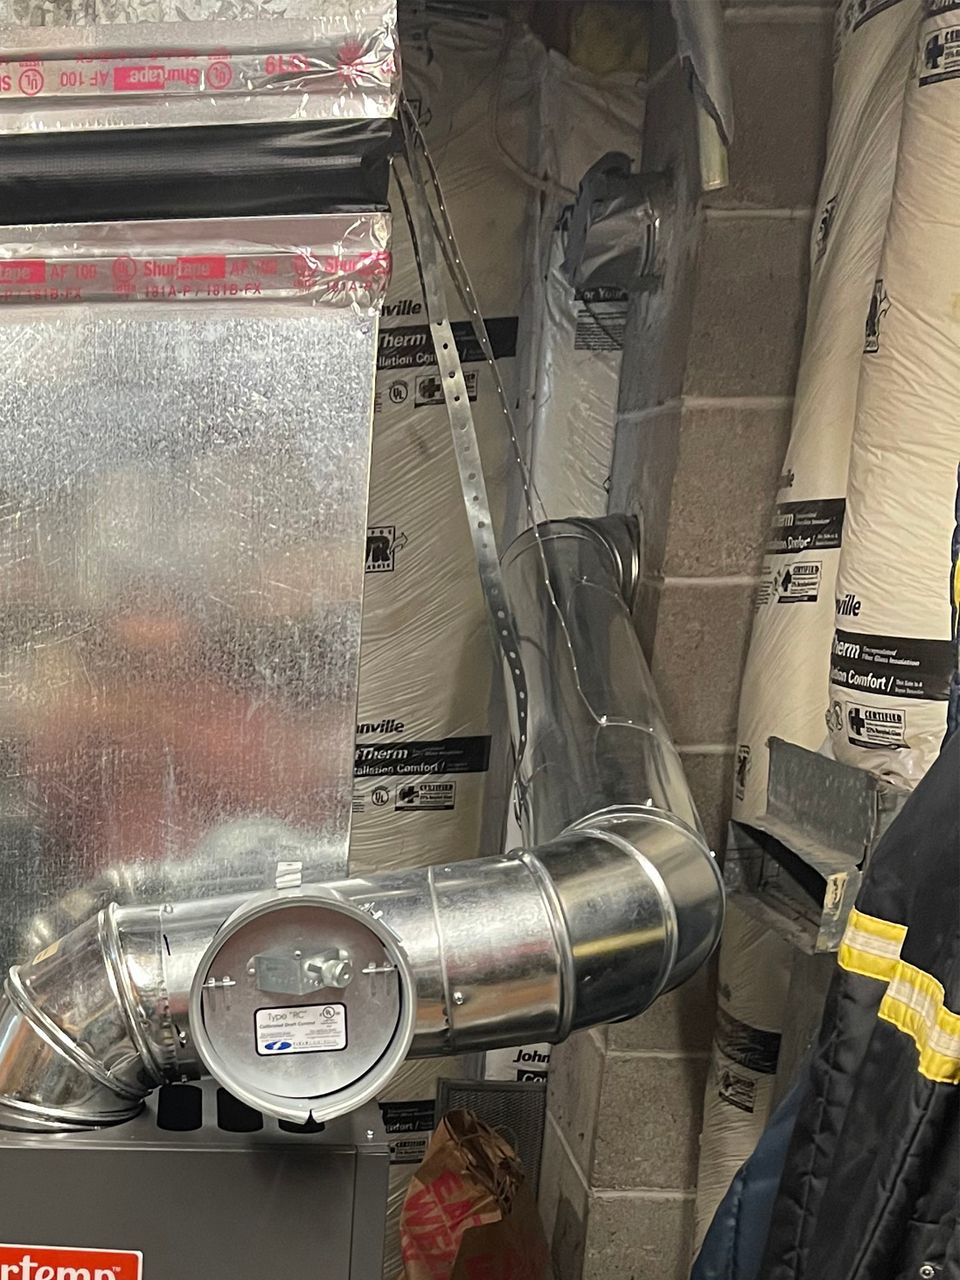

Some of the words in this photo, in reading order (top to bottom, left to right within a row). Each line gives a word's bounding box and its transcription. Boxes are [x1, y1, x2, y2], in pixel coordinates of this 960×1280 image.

[60, 71, 85, 87] 100
[848, 669, 887, 691] Comfort
[396, 761, 439, 774] Comfort
